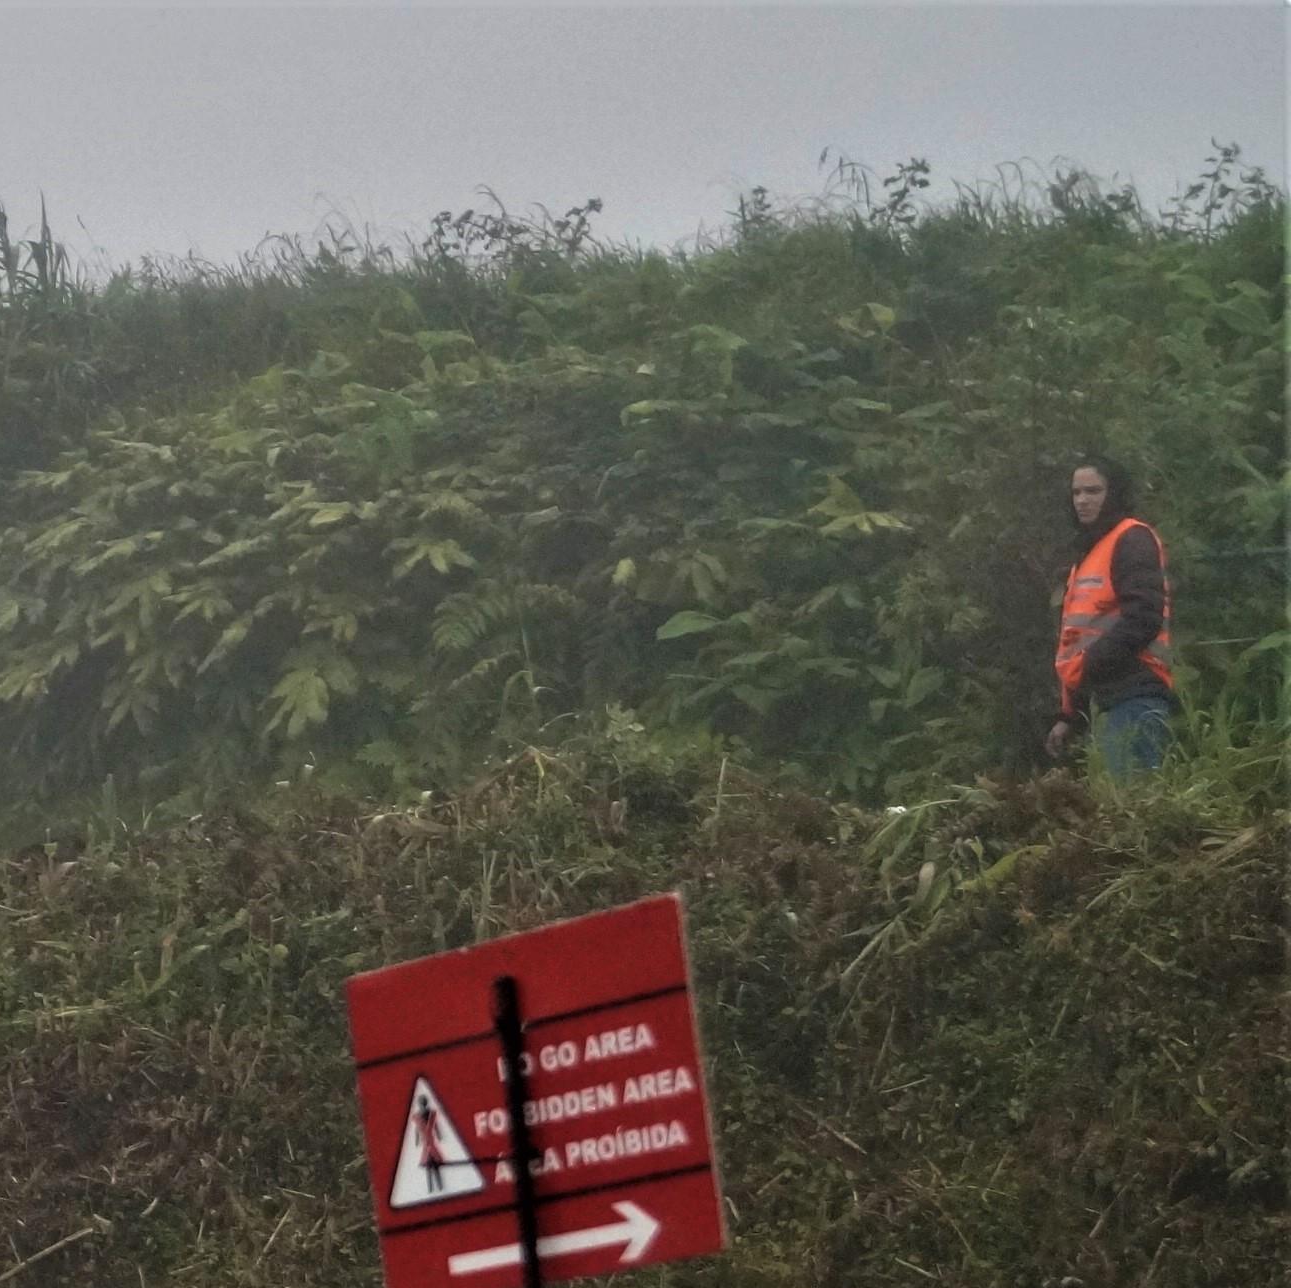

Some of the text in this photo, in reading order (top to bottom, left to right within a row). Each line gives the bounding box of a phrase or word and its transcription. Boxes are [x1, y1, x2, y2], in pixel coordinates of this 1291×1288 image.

[540, 1041, 578, 1072] GO
[584, 1024, 654, 1061] AREA
[474, 1066, 695, 1138] FOBIDDEN AREA
[566, 1119, 690, 1167] PROÍBIDA
